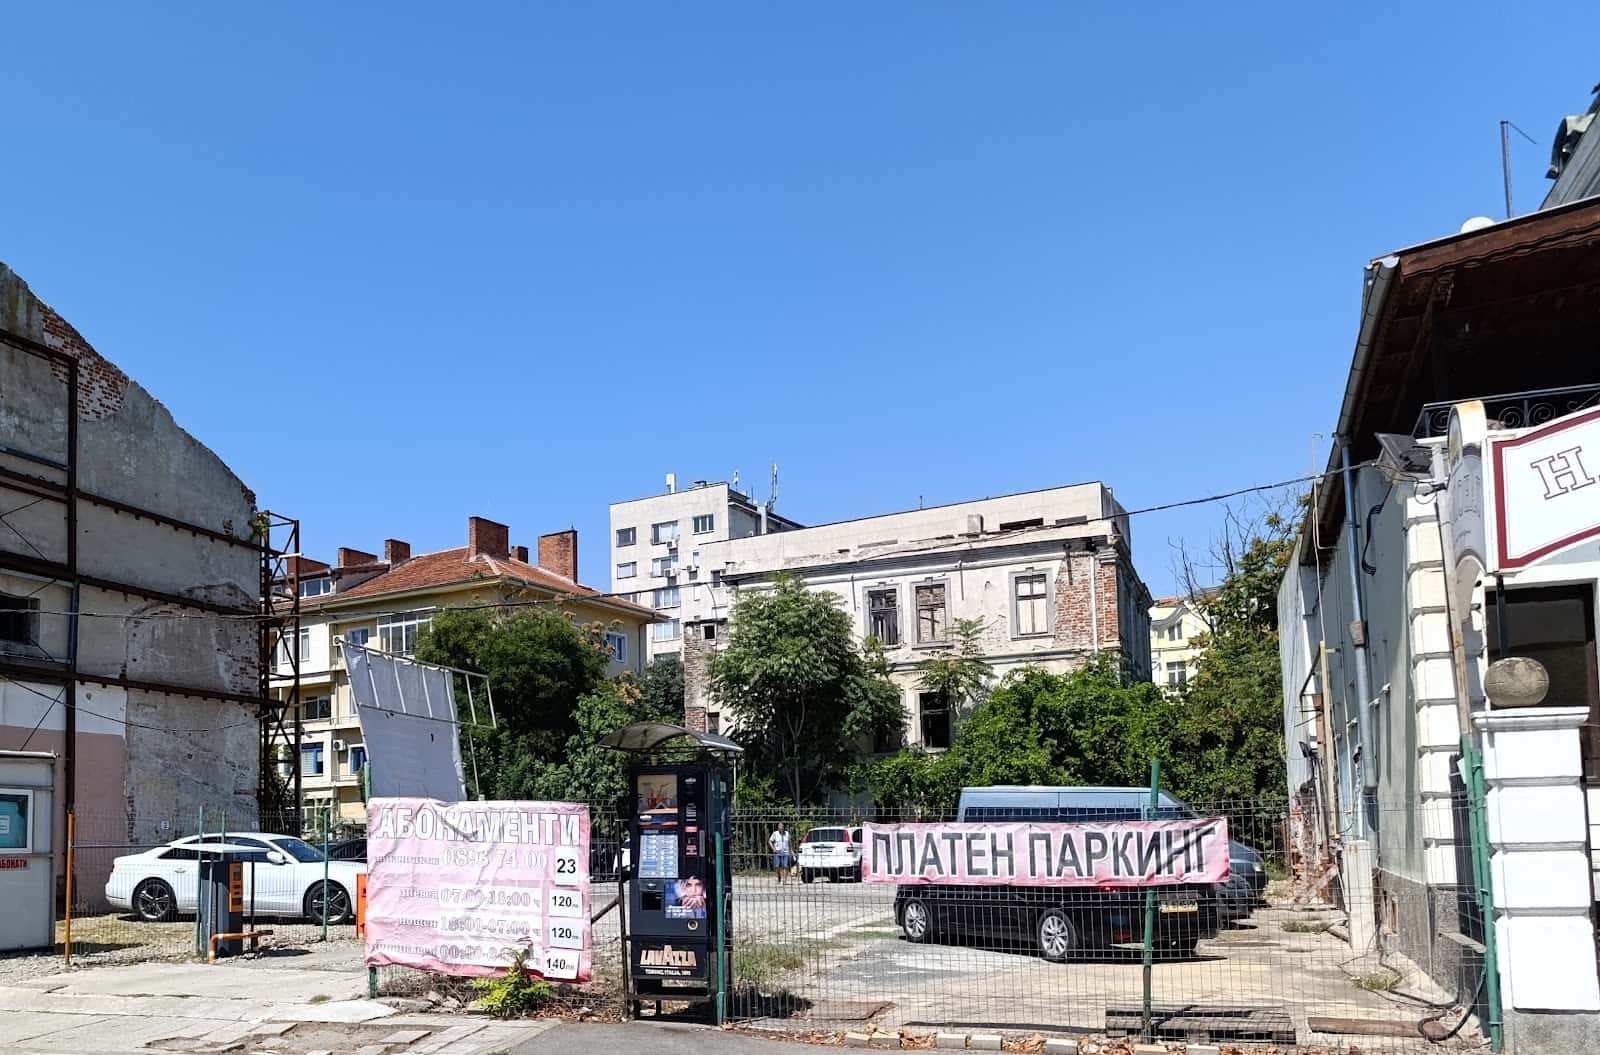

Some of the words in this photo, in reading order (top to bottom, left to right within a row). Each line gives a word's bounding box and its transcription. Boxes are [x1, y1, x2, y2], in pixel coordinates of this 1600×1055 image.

[1530, 446, 1600, 500] Н
[376, 808, 580, 846] АБОНАМЕНТИ
[872, 832, 1015, 876] ПЛАТЕН
[1029, 828, 1215, 877] ПАРКИНГ
[556, 858, 576, 874] 23
[552, 896, 572, 908] 120
[552, 928, 572, 939] 120
[547, 958, 566, 970] 140
[640, 945, 697, 967] LAVAZZA
